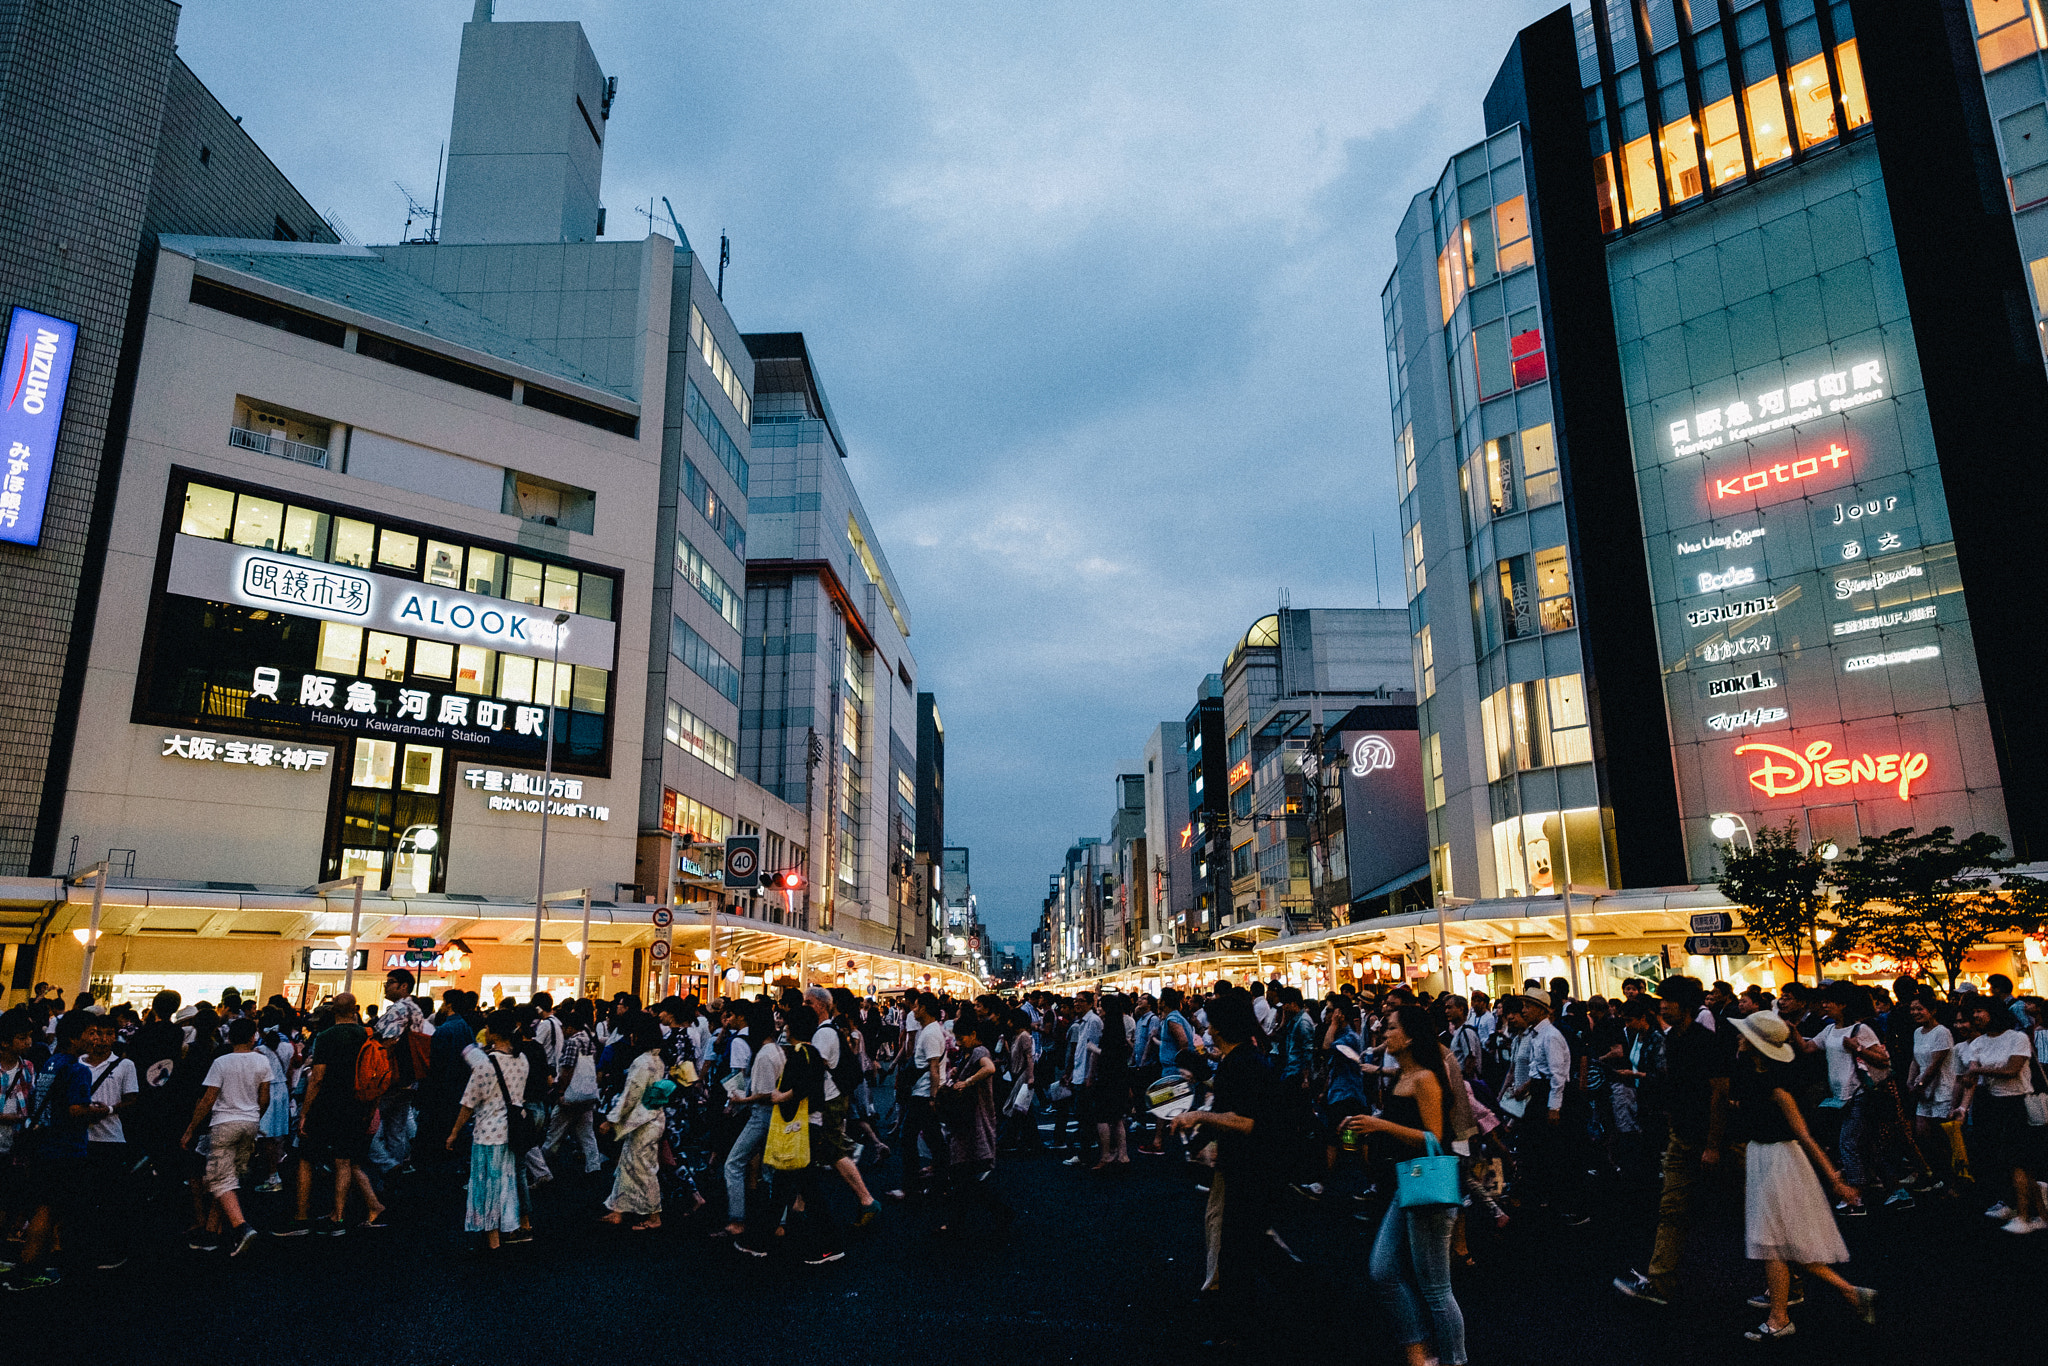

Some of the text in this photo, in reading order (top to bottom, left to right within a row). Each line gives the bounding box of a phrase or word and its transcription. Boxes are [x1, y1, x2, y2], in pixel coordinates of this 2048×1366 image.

[23, 328, 59, 415] MIZUHO
[1675, 388, 1883, 457] Hankyu Kawaramachi Station
[0, 441, 30, 528] みずほ銀行
[252, 564, 364, 610] 眼鏡市場
[400, 596, 527, 640] ALOOK
[1687, 596, 1778, 627] サンマルクカフェ
[1703, 635, 1771, 661] 鎌倉パスタ
[1708, 676, 1746, 697] BOOK
[311, 710, 490, 744] Hankyu Kawaramachi Station
[734, 856, 751, 869] 40
